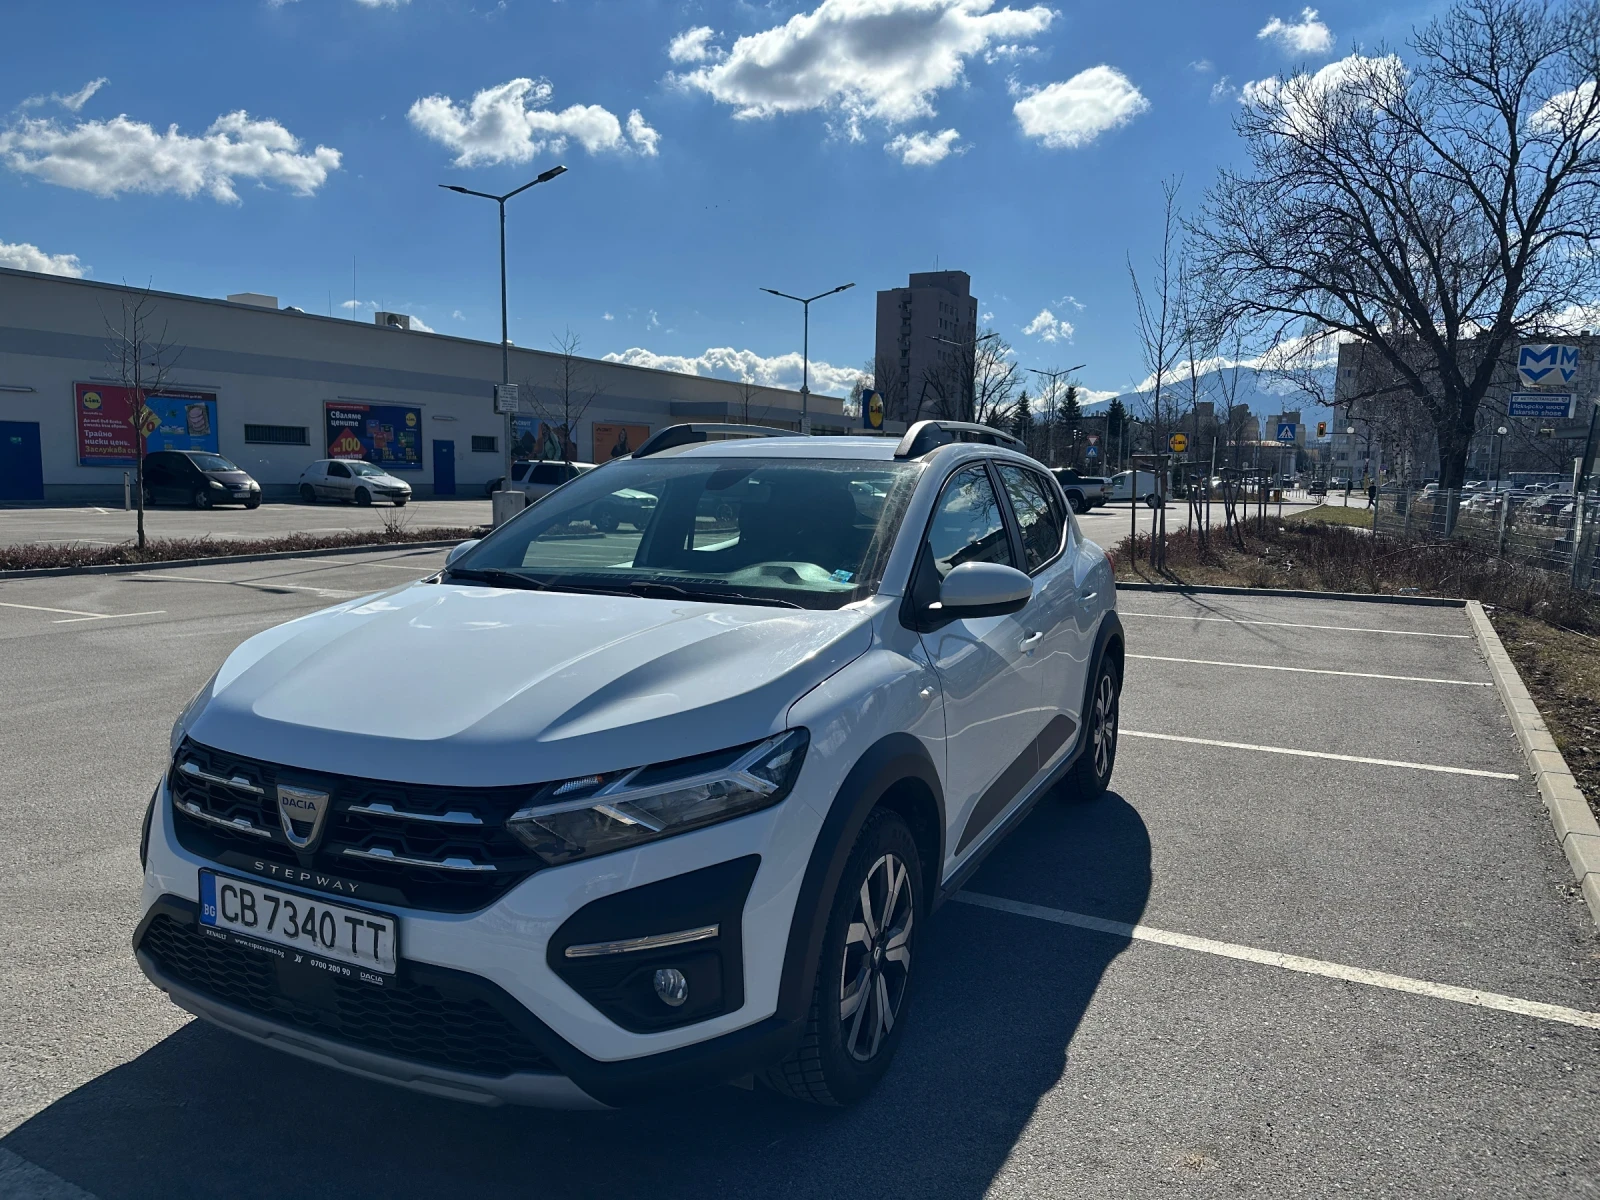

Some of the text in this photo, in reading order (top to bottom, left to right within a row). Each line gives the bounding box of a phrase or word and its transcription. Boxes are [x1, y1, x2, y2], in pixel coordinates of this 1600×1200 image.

[330, 411, 362, 420] Сваляме
[84, 430, 112, 438] Трайно
[85, 445, 127, 454] Заслужава
[341, 438, 360, 452] 100
[281, 796, 317, 811] DACIA
[254, 861, 360, 893] STEPWAY
[204, 903, 216, 917] BG
[220, 884, 387, 964] CB 7340 TT
[206, 929, 227, 941] RENAULT
[310, 959, 327, 971] 0700
[328, 962, 341, 974] 200
[341, 966, 351, 976] 90
[360, 972, 383, 982] DACIA
